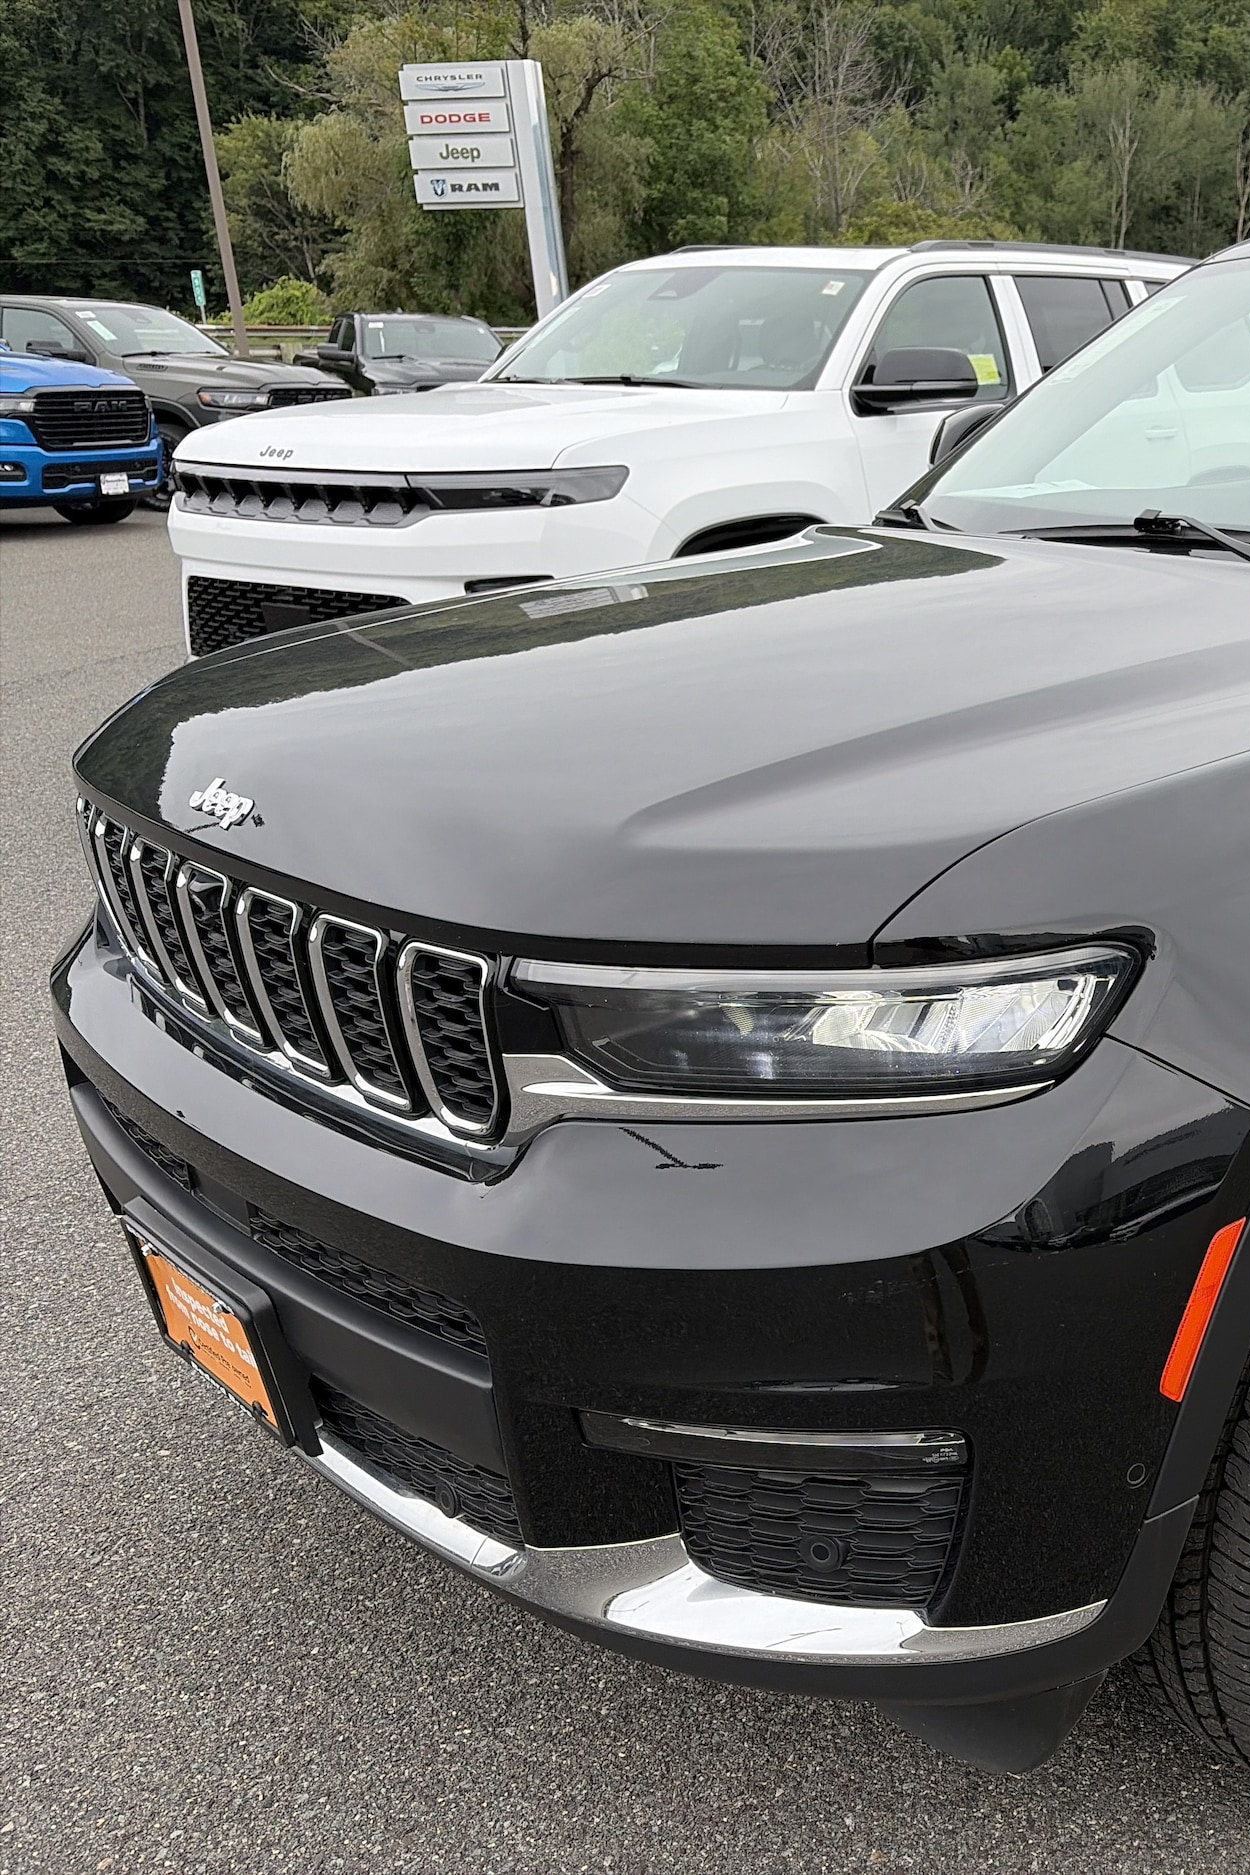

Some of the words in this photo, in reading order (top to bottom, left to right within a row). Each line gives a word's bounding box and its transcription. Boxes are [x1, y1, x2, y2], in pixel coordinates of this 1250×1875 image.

[416, 74, 483, 82] CHRYSLER
[420, 113, 491, 124] DODGE
[439, 144, 481, 162] Jeep
[450, 182, 500, 192] RAM
[73, 401, 127, 412] RAM
[259, 445, 294, 461] Jeep
[189, 777, 255, 831] Jeep
[191, 1313, 221, 1342] nose
[219, 1331, 236, 1353] to
